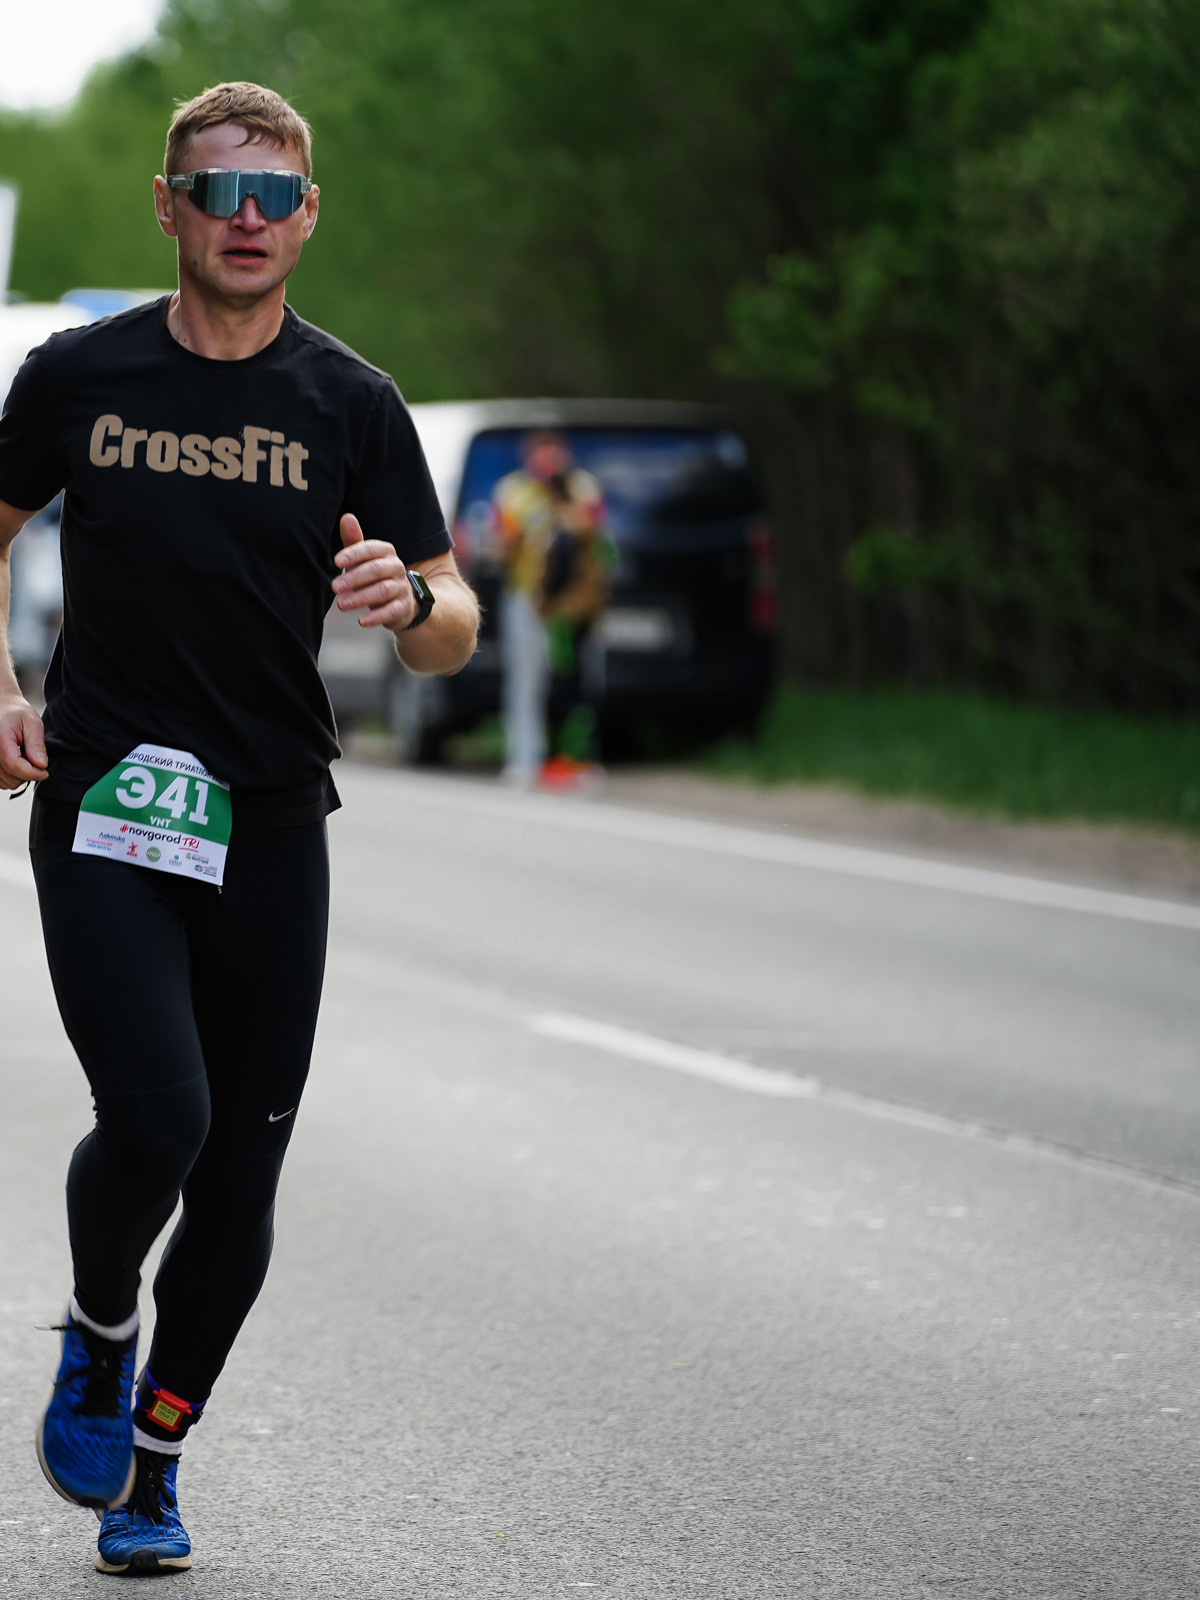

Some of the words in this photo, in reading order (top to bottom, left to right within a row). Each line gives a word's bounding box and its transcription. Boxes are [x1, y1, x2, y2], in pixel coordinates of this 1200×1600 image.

[90, 414, 308, 491] CrossFit
[126, 752, 173, 767] ОРОДСКИЙ
[116, 766, 209, 826] Э41
[150, 815, 172, 829] VNT
